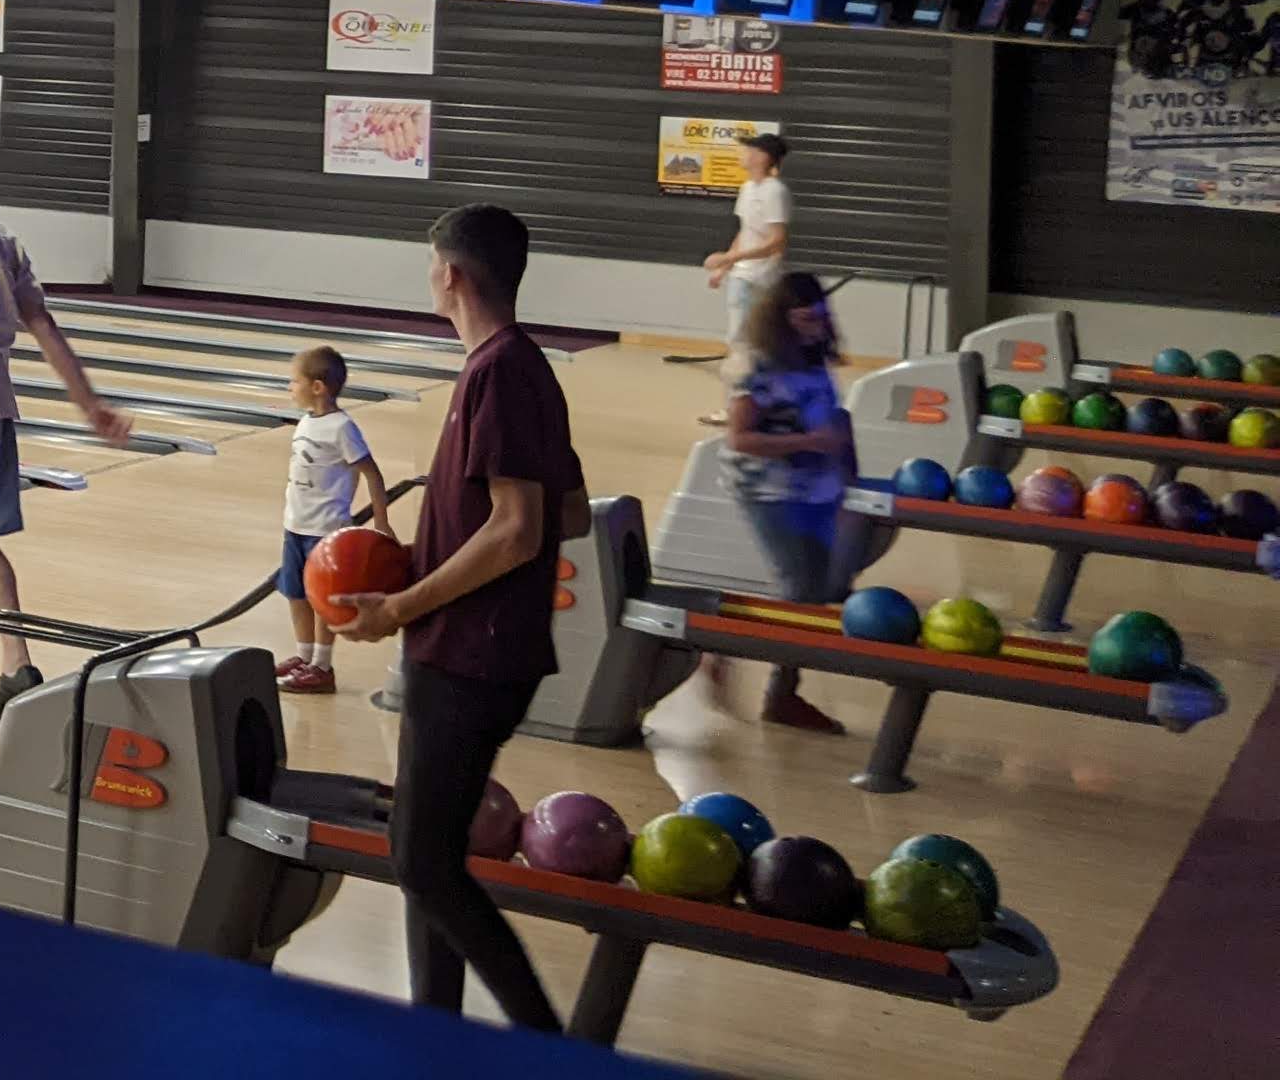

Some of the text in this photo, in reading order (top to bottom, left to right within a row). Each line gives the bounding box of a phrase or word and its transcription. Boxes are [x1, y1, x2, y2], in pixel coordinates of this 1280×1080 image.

[710, 53, 774, 70] FORTIS
[697, 69, 710, 79] 02
[712, 70, 725, 80] 31
[727, 71, 741, 81] 09
[743, 71, 756, 81] 41
[1168, 111, 1194, 127] US
[95, 776, 153, 798] Brunswick
